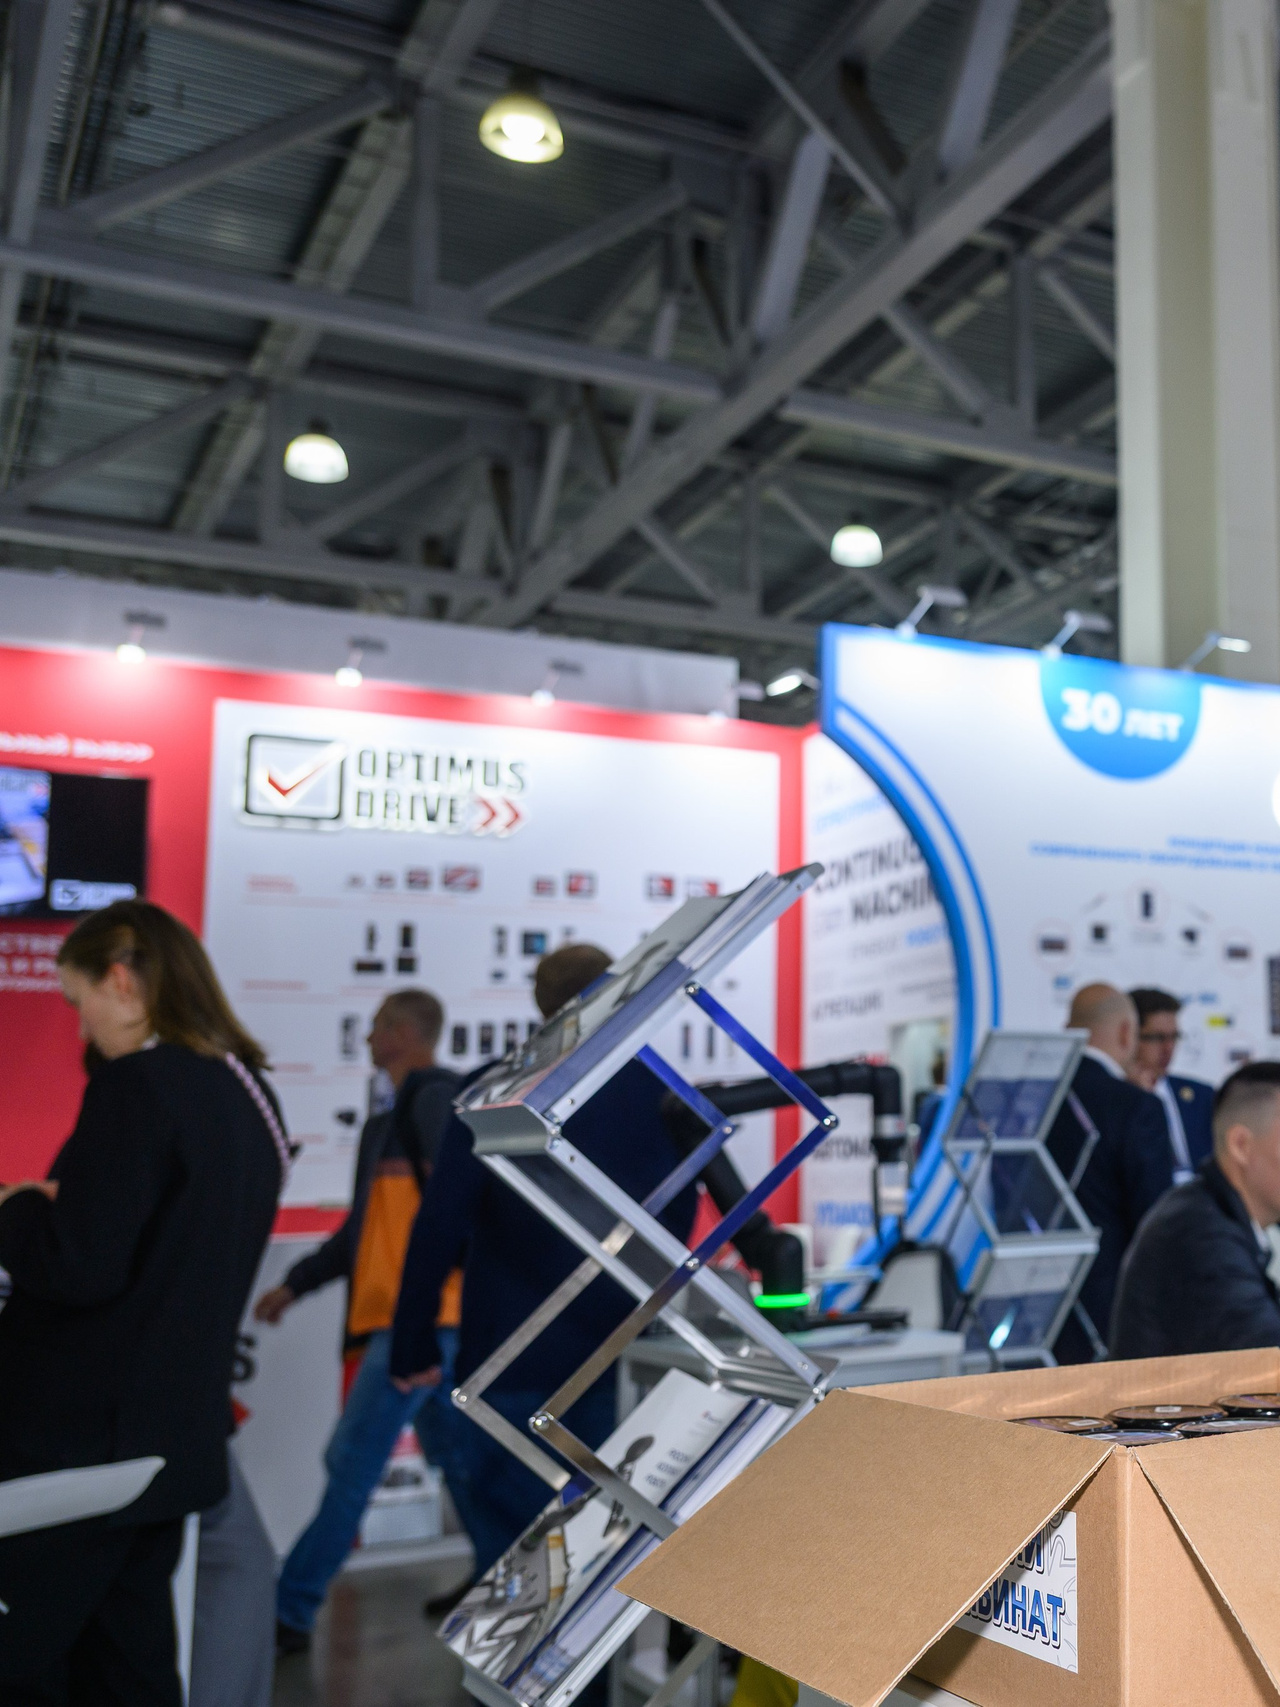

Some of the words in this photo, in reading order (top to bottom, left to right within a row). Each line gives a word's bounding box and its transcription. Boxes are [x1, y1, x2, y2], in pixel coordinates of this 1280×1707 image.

[1061, 687, 1122, 735] 30
[357, 748, 527, 794] OPTIMUS
[355, 786, 463, 826] DRIVE
